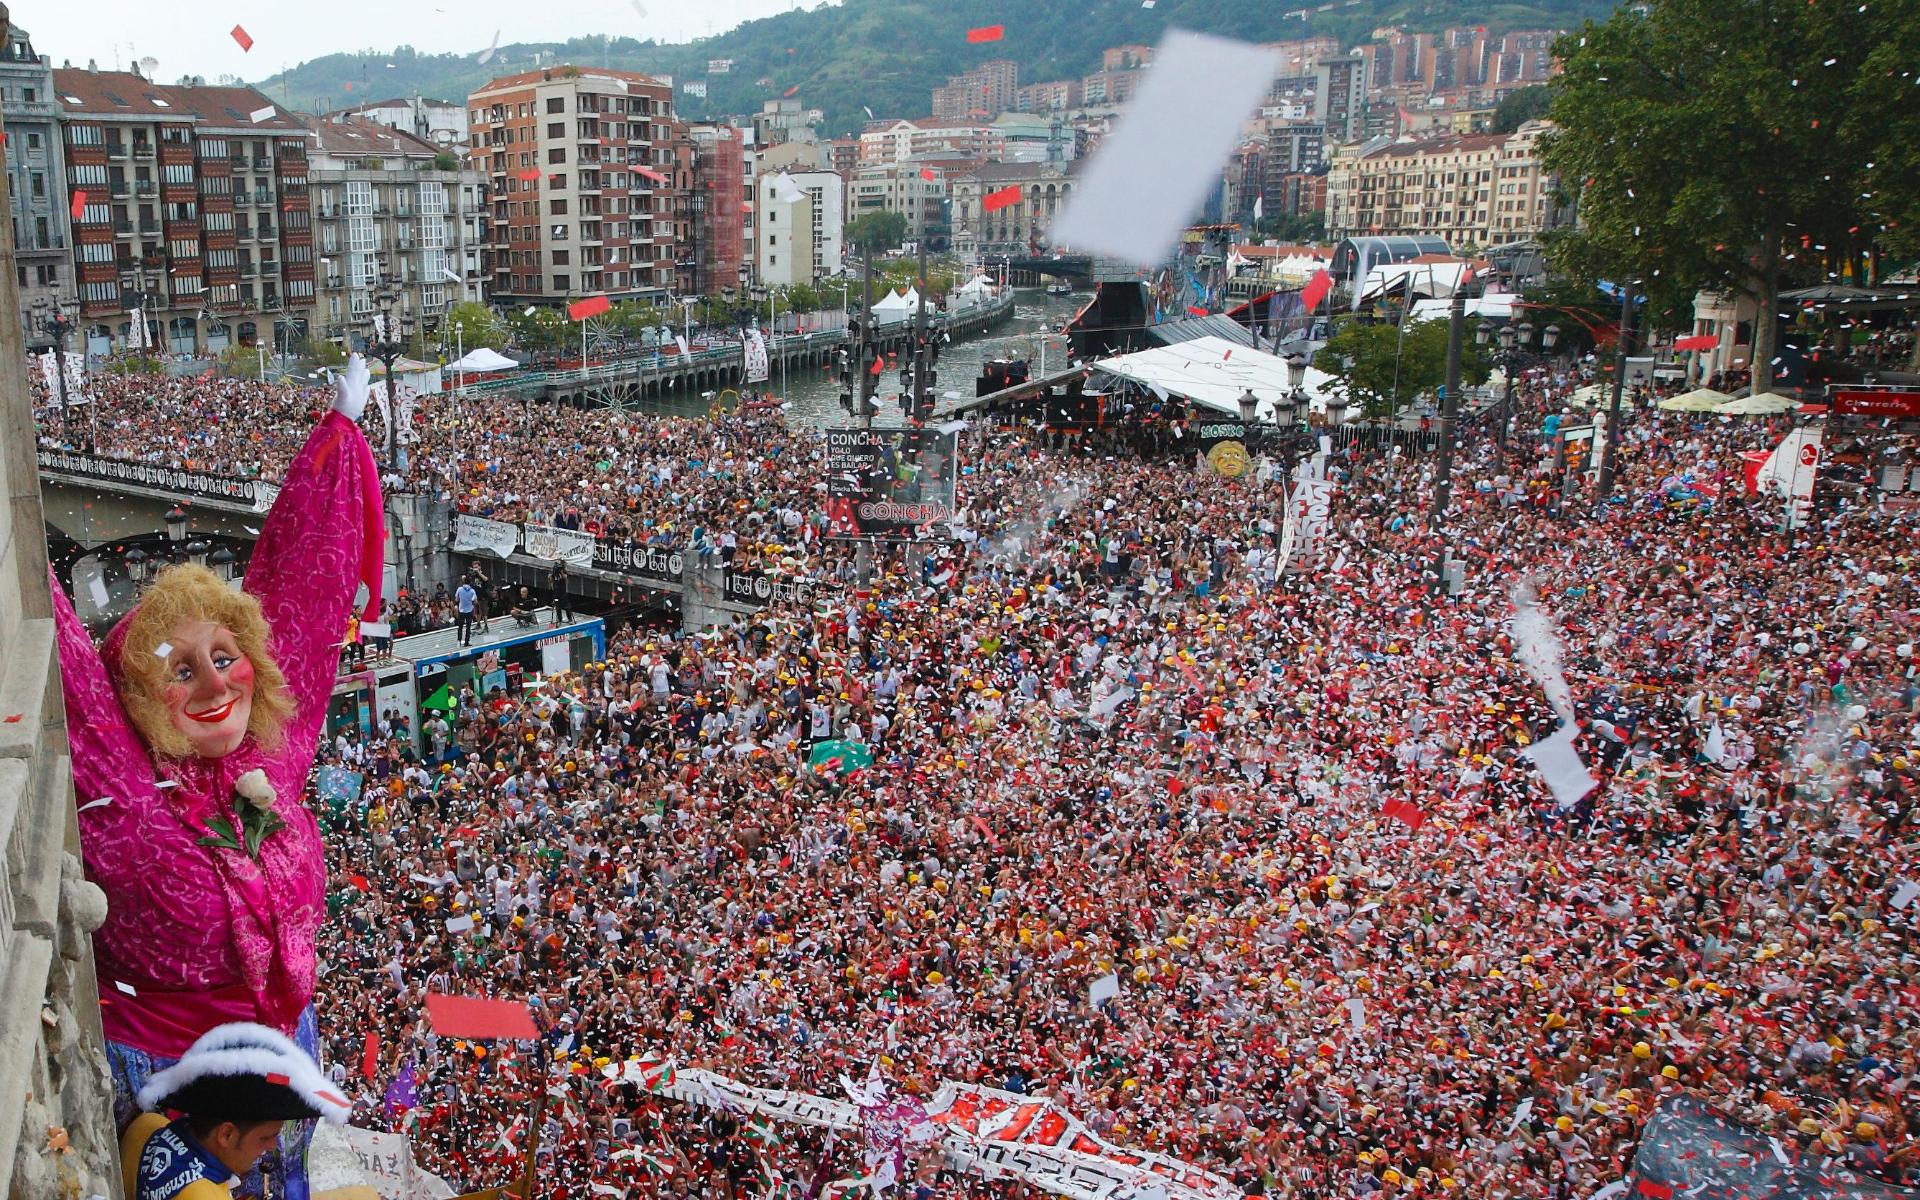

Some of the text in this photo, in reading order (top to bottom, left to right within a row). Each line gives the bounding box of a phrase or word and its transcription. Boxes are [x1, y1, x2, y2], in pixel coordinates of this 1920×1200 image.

[831, 461, 840, 469] ES
[858, 502, 950, 521] CONCHA
[161, 1128, 189, 1156] BILBO
